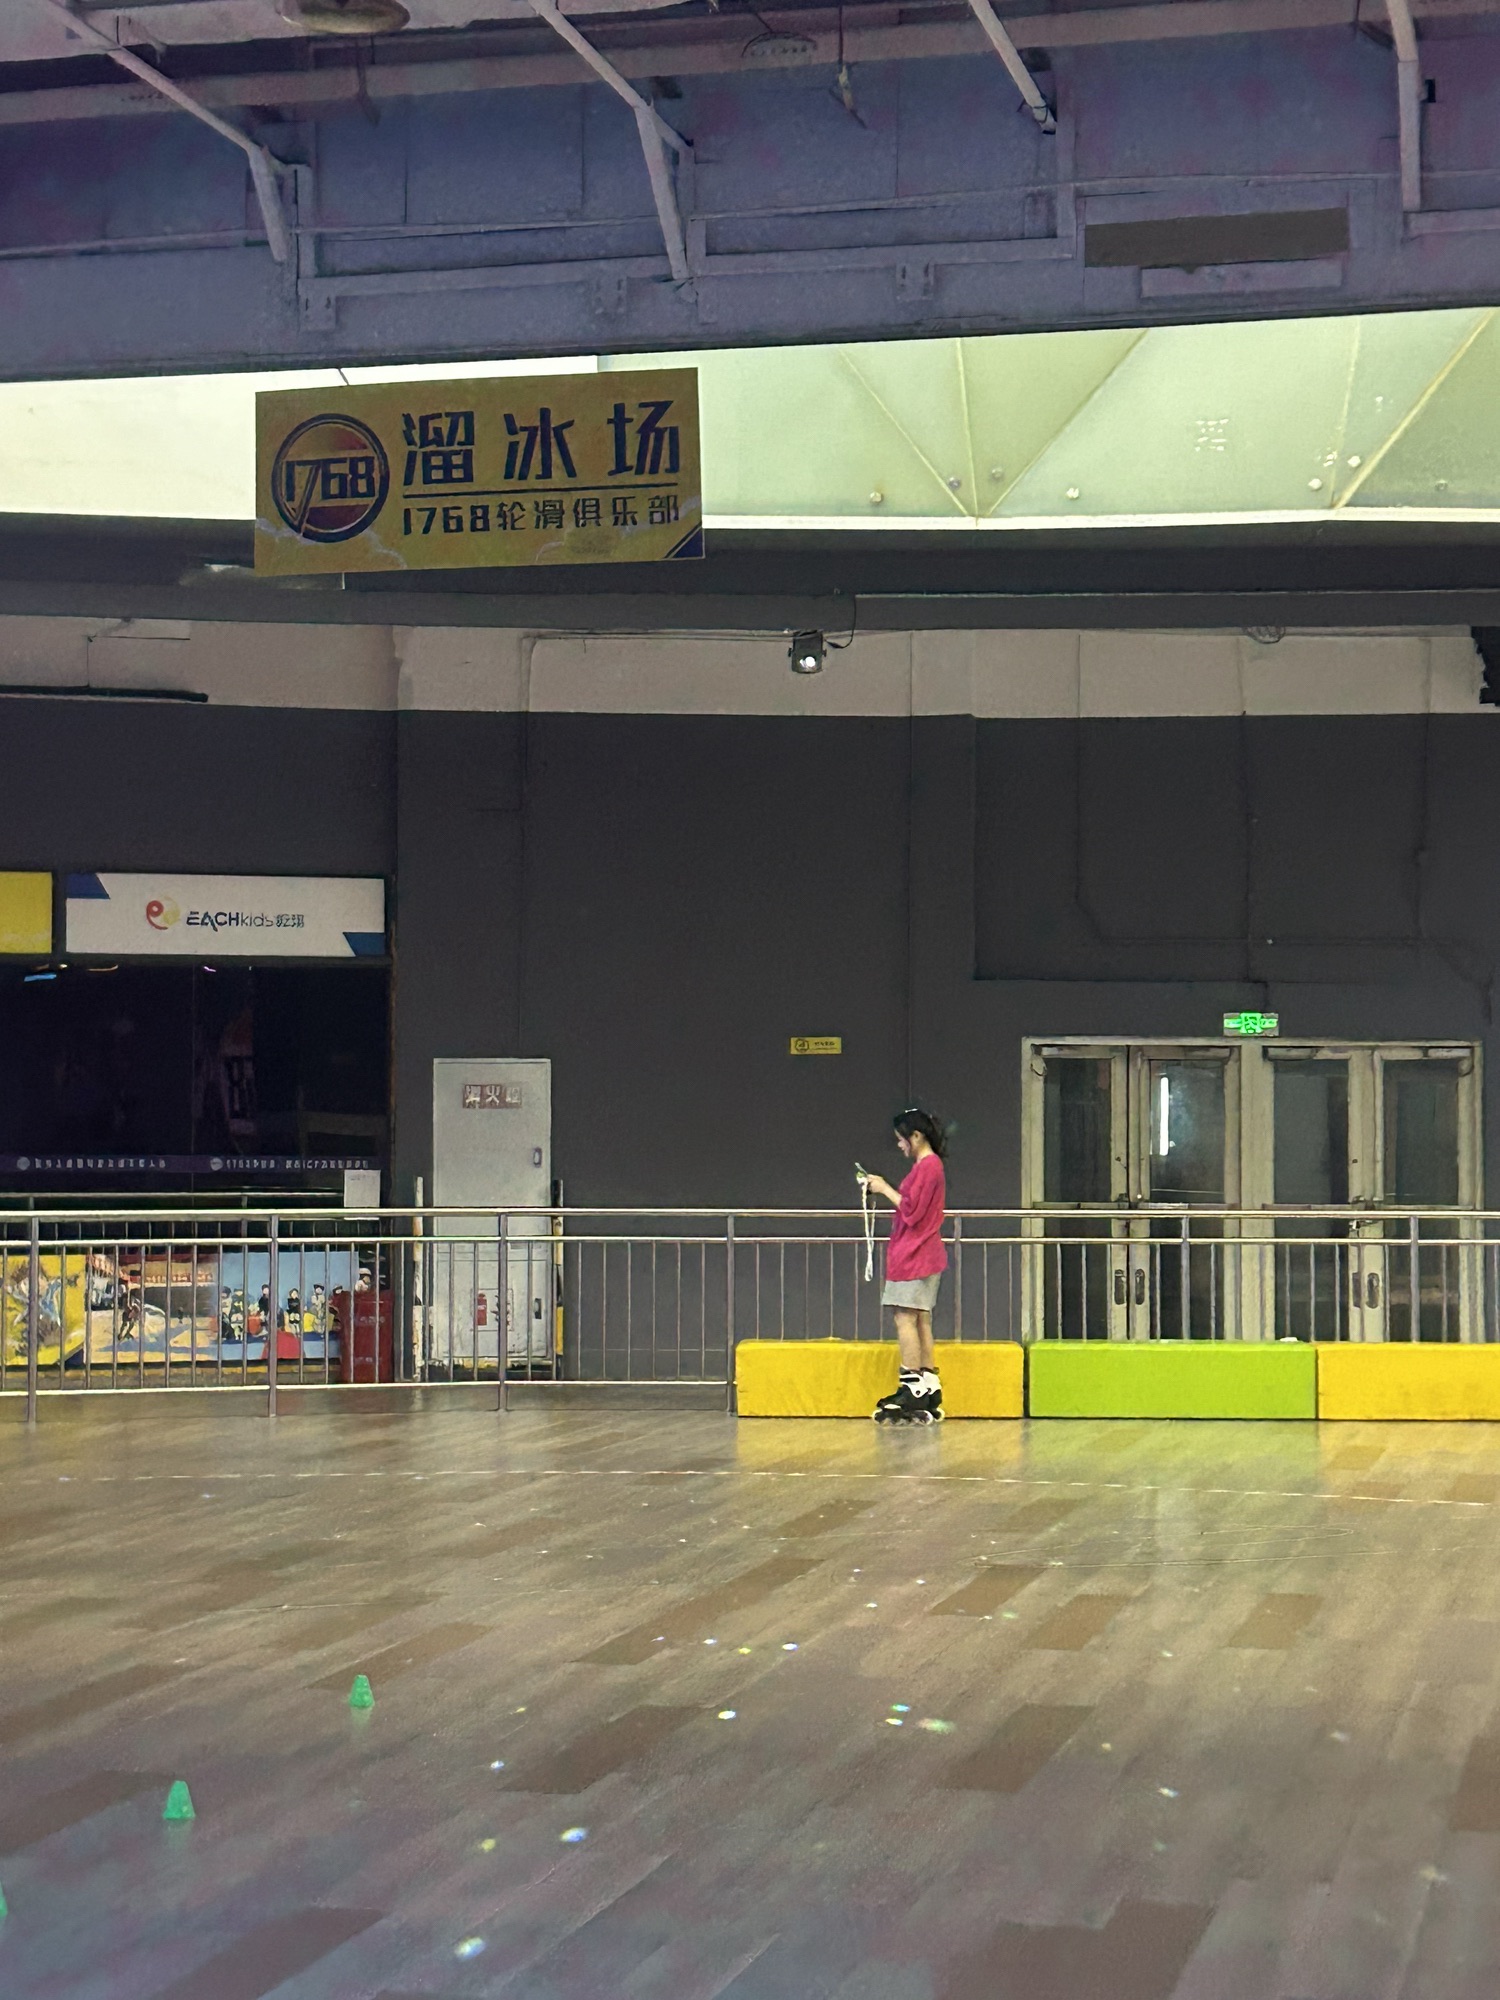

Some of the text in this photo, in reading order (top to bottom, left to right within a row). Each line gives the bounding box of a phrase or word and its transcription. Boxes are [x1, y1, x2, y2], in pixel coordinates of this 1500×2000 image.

[402, 400, 680, 486] 溜冰场
[283, 456, 376, 533] 1768
[403, 494, 680, 535] 1768轮滑俱乐部
